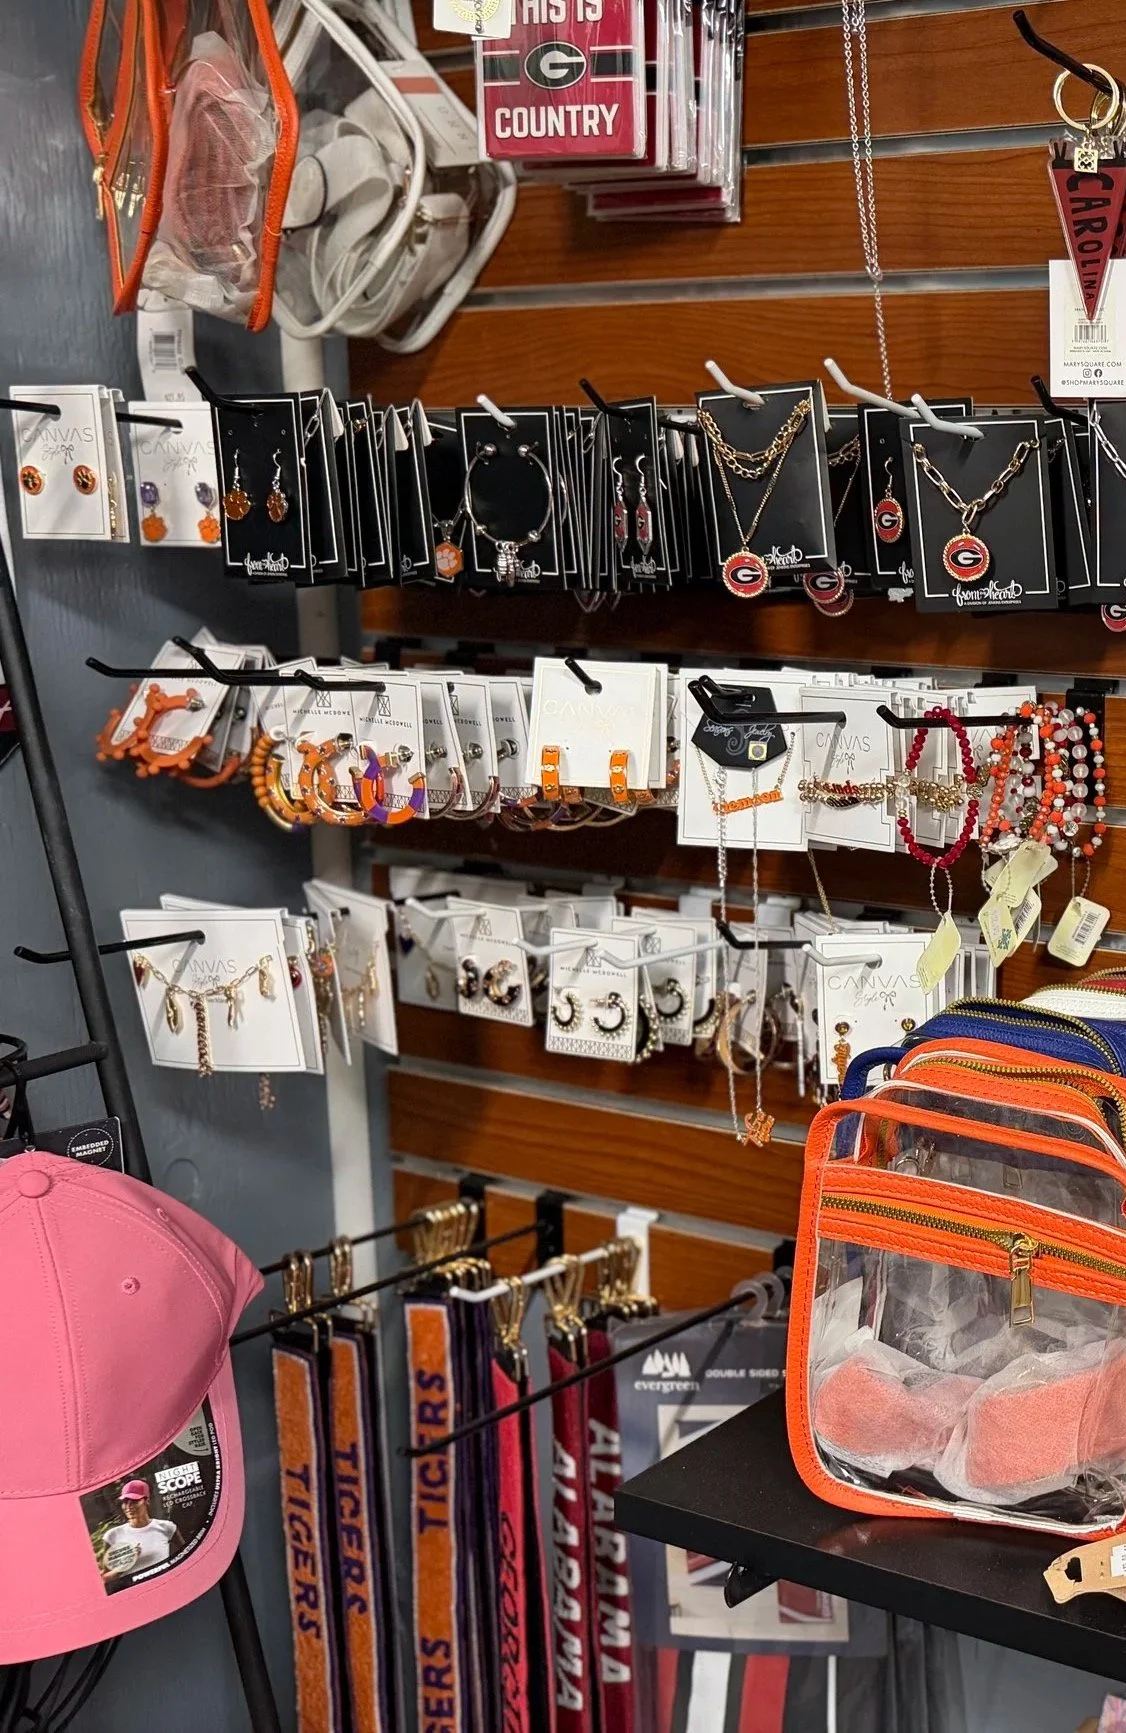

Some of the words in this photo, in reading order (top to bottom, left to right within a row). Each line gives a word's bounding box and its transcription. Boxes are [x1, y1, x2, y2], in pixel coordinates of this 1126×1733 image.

[511, 0, 567, 25] HIS
[577, 0, 603, 23] IS
[494, 104, 619, 139] COUNTRY
[1066, 172, 1114, 300] CAROLINA
[899, 561, 914, 583] fro
[816, 733, 871, 752] CANVAS
[828, 975, 921, 990] CANVAS
[71, 1140, 109, 1153] EMBEDDED
[76, 1147, 106, 1157] MAGNET
[634, 1381, 700, 1394] evergreen
[705, 1368, 746, 1378] DOUBLE
[749, 1368, 779, 1378] SIDED
[158, 1463, 196, 1480] NIGHT
[158, 1471, 202, 1494] SCOPE
[285, 1464, 321, 1640] TIGERS
[589, 1418, 632, 1684] ALABAMA
[552, 1438, 584, 1711] ALABAMA
